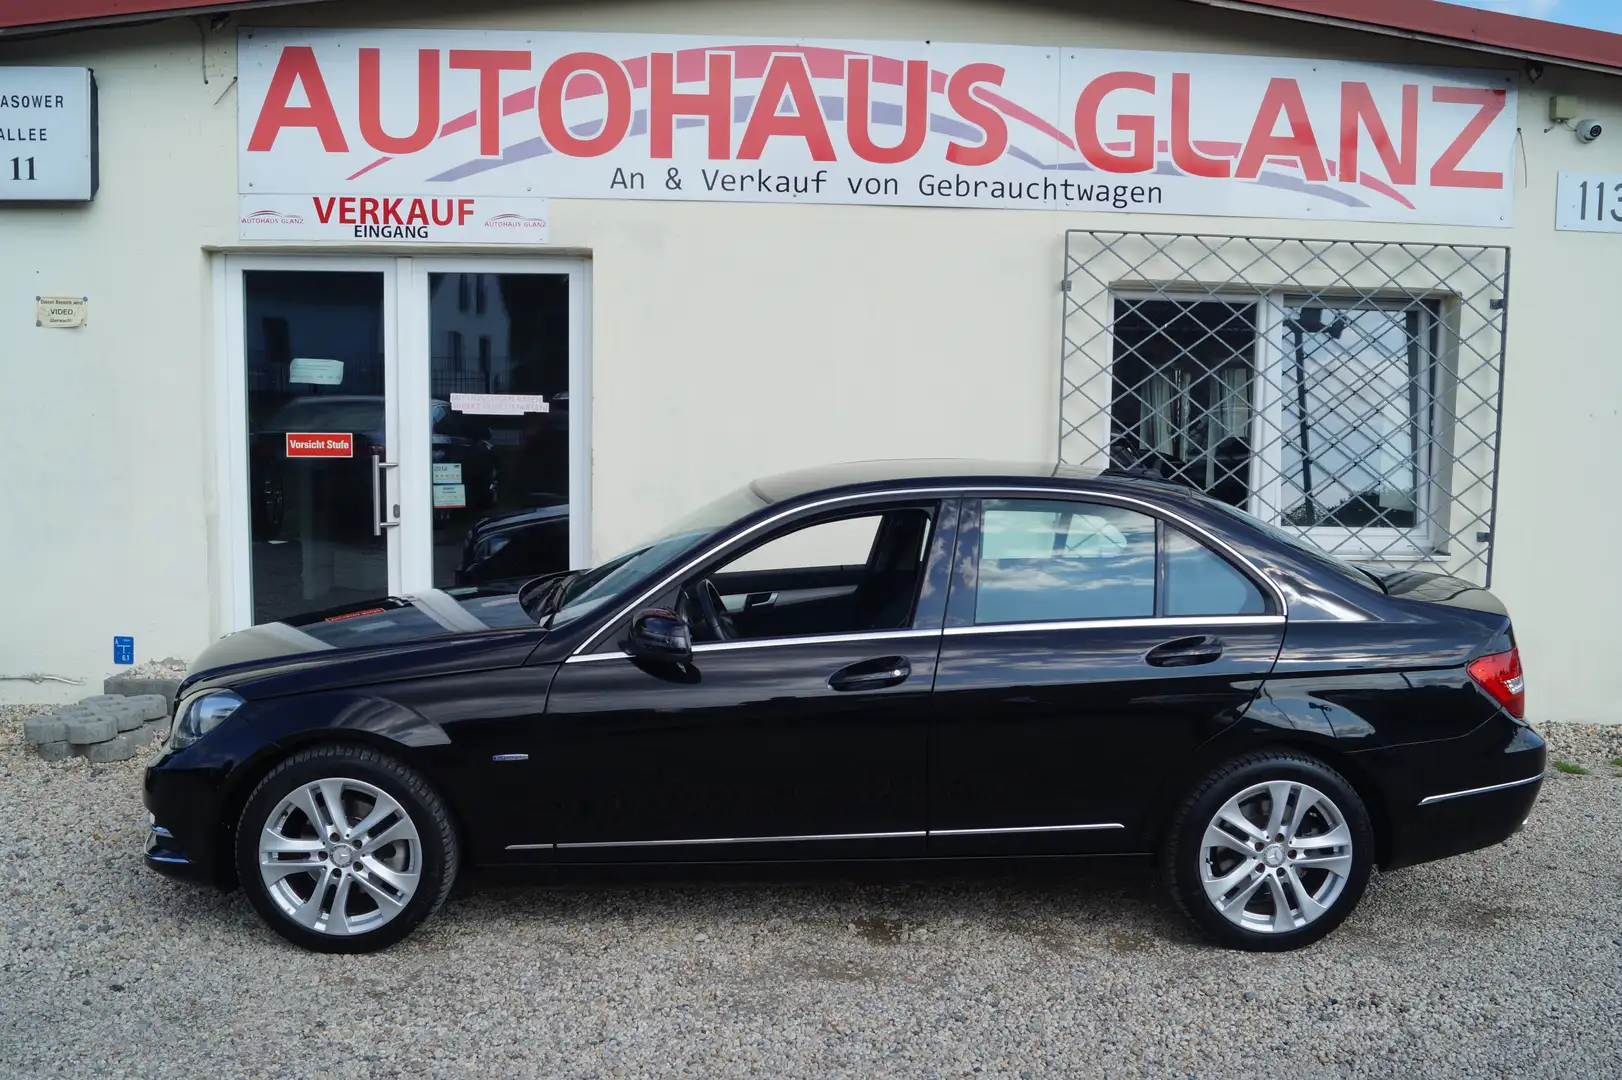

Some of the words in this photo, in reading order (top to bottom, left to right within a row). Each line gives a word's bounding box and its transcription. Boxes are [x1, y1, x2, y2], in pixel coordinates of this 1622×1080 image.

[247, 46, 1008, 166] AUTOHAUS
[1074, 70, 1507, 190] GLANZ
[0, 128, 47, 141] ALLEE
[10, 156, 37, 180] 11
[610, 167, 645, 190] An
[665, 167, 683, 191] &
[701, 168, 828, 193] Verkauf
[847, 176, 898, 195] von
[918, 174, 1163, 209] Gebrauchtwagen
[312, 197, 475, 226] VERKAUF
[354, 225, 429, 239] EINGANG
[50, 308, 74, 316] VIDEO
[289, 440, 325, 449] Vorsicht
[326, 440, 349, 449] Stufe
